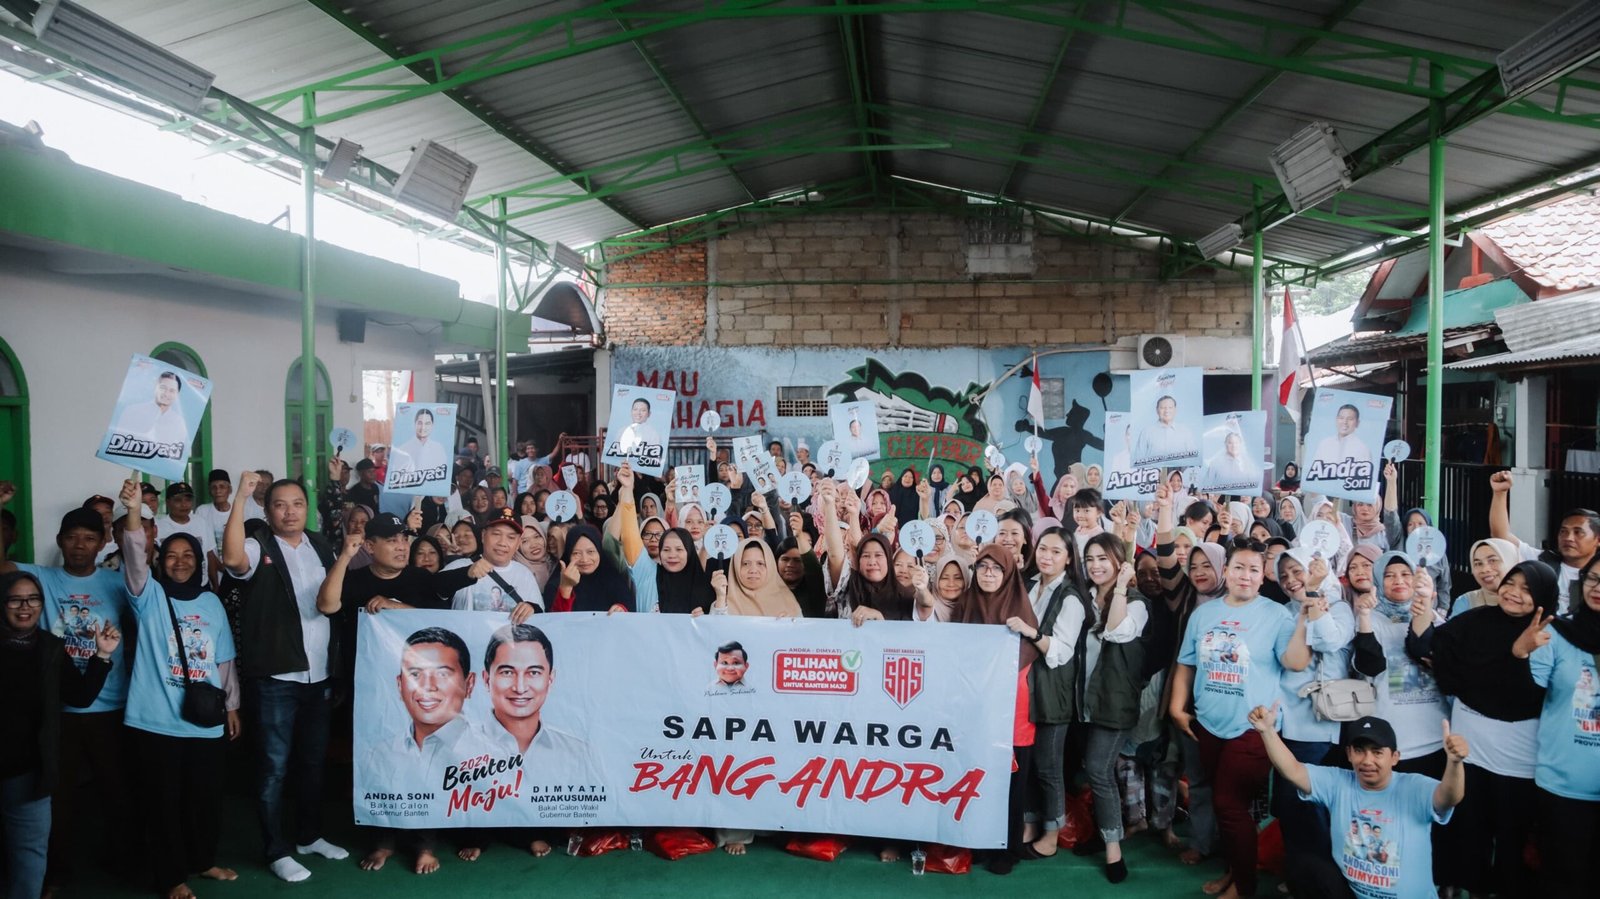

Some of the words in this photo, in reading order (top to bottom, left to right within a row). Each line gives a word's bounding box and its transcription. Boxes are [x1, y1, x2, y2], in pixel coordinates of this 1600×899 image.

[107, 434, 184, 460] Dimyati
[606, 441, 662, 458] Adra
[389, 464, 448, 488] Dimyati
[1106, 467, 1160, 490] Andra
[1307, 457, 1372, 480] Andra
[1138, 482, 1157, 494] Son
[1343, 476, 1371, 489] Soni
[783, 657, 838, 669] PILIHAN
[783, 670, 848, 682] PRABOWO
[885, 657, 922, 704] SAS
[662, 715, 776, 742] SAPA
[793, 720, 955, 752] WARGA
[640, 747, 693, 760] Untuk
[442, 754, 524, 791] Banten
[447, 769, 522, 817] Maju!
[532, 785, 605, 793] DIMYATI
[629, 754, 776, 800] BANG
[778, 756, 986, 821] ANDRA
[1343, 854, 1372, 874] ANDRA
[1374, 864, 1399, 877] SONI
[1347, 866, 1390, 887] DIMYATI
